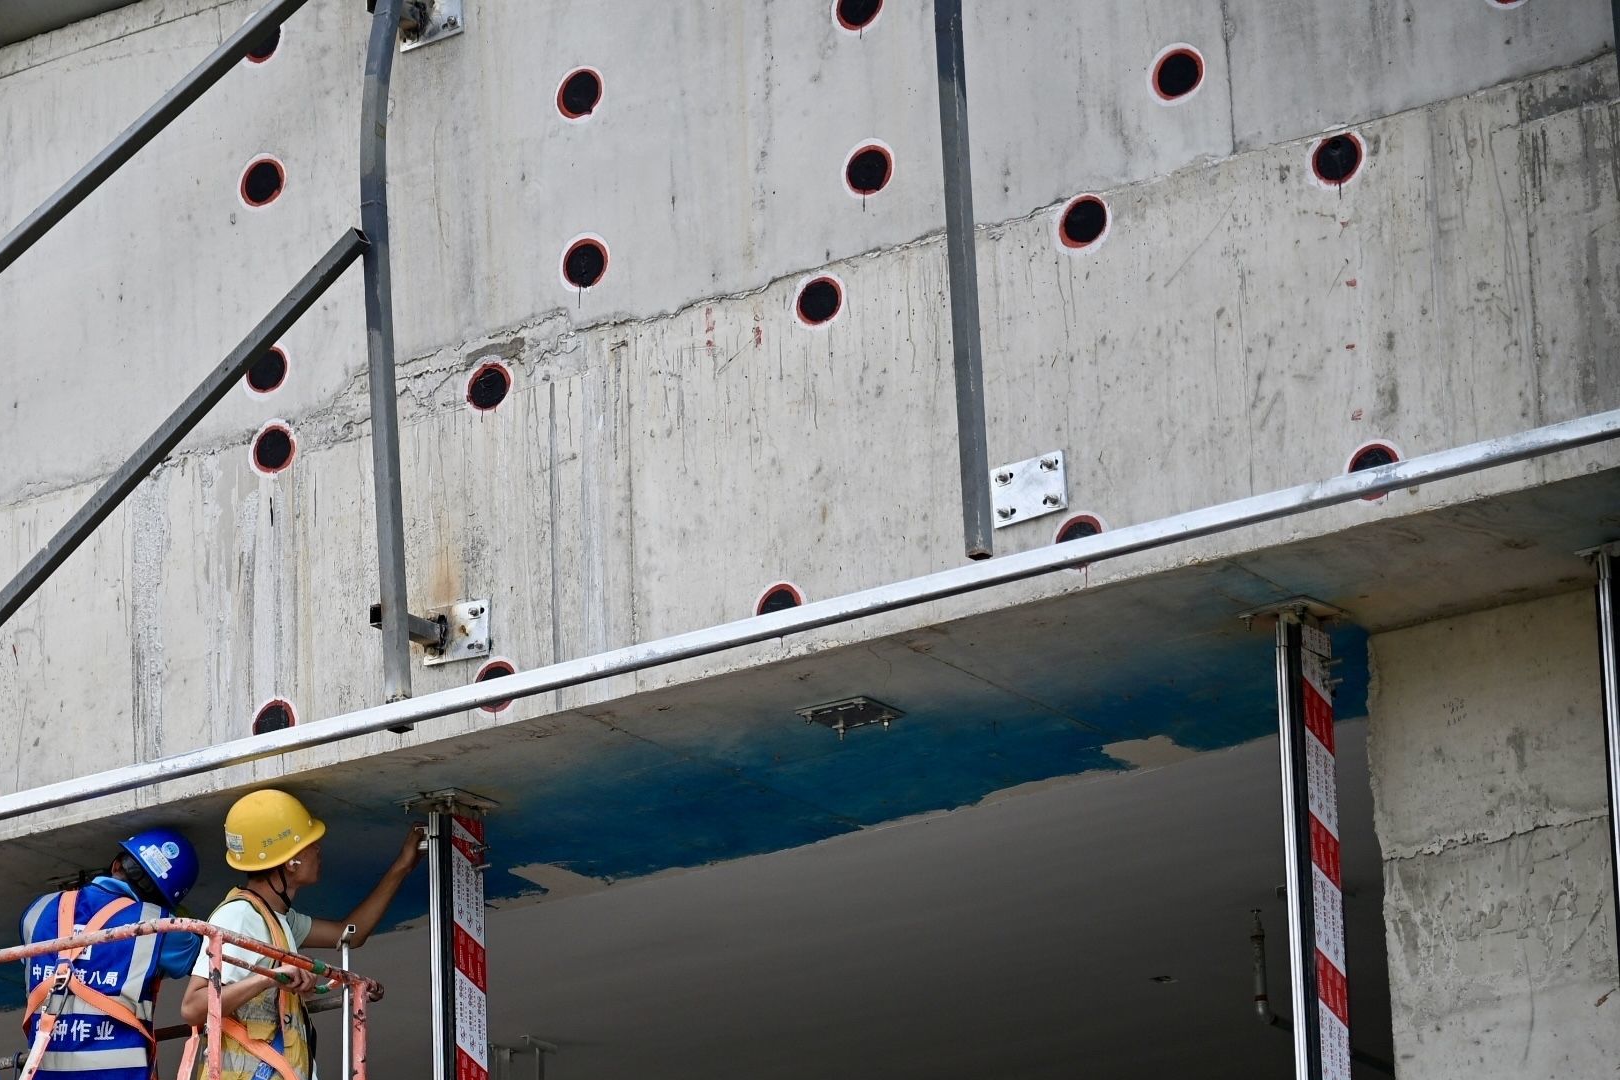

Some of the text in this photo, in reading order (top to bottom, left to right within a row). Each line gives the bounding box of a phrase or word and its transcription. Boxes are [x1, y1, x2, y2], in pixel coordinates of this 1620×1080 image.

[33, 964, 118, 987] 中国筑八局
[36, 1020, 115, 1041] 种作业
